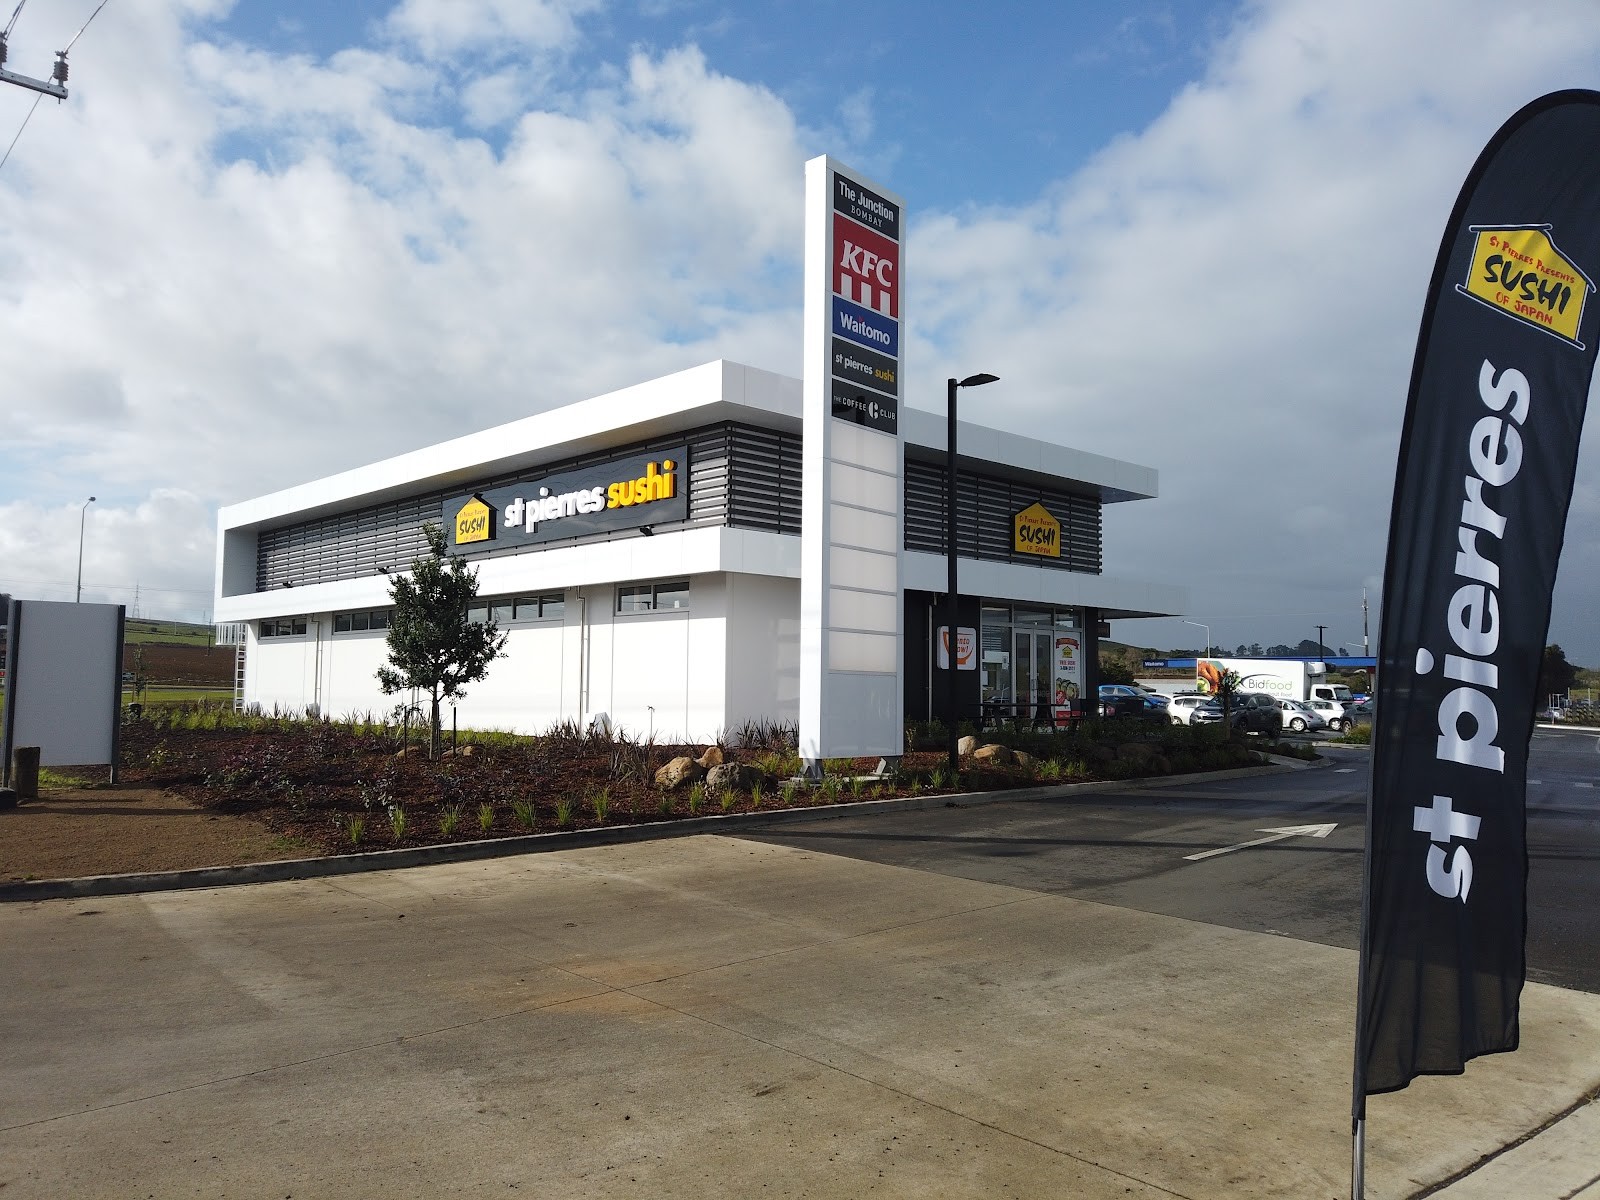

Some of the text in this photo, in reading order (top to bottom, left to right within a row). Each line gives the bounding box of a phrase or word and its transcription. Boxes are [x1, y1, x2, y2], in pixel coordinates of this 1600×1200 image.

[839, 180, 894, 223] The Junction
[850, 204, 883, 228] BOMBAY
[840, 239, 894, 288] KFC
[1483, 254, 1572, 315] SUSHI
[1495, 291, 1553, 325] OF JAPAN
[840, 311, 891, 345] Waitomo
[835, 353, 895, 383] st pierres sushi
[842, 397, 867, 412] COFFEE
[880, 408, 896, 420] CLUB
[504, 459, 679, 534] st pierres sushi
[459, 515, 486, 536] SUSHI
[1019, 524, 1056, 546] SUSHI
[1413, 358, 1531, 904] st pierres
[1248, 678, 1293, 691] Bidfood
